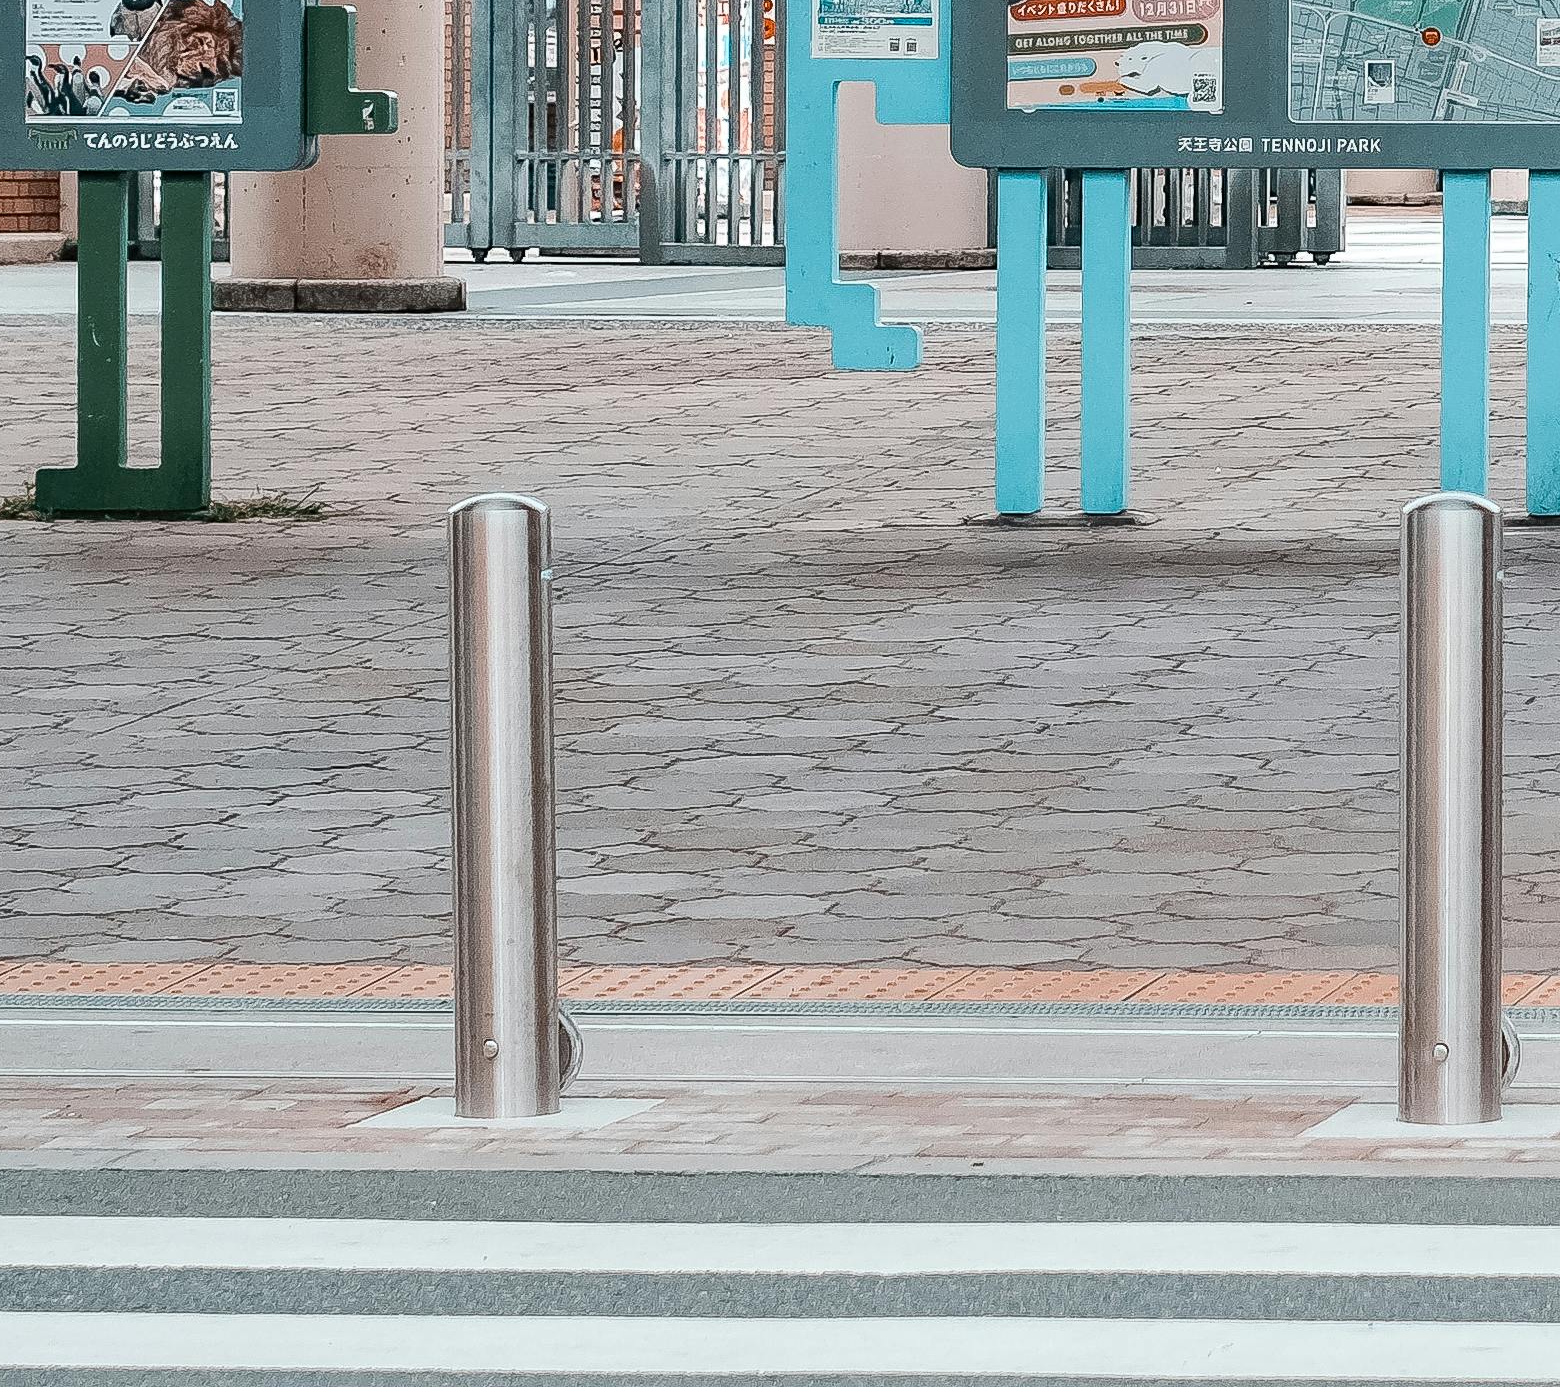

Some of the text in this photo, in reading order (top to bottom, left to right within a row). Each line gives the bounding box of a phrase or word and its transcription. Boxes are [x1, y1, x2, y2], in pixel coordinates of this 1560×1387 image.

[1015, 29, 1188, 49] GET ALONG TOGETHER ALL THE TIME
[83, 131, 239, 151] てんのうじどうぶつえん
[1178, 137, 1381, 153] 天王寺公園 TENNOJI PARK
